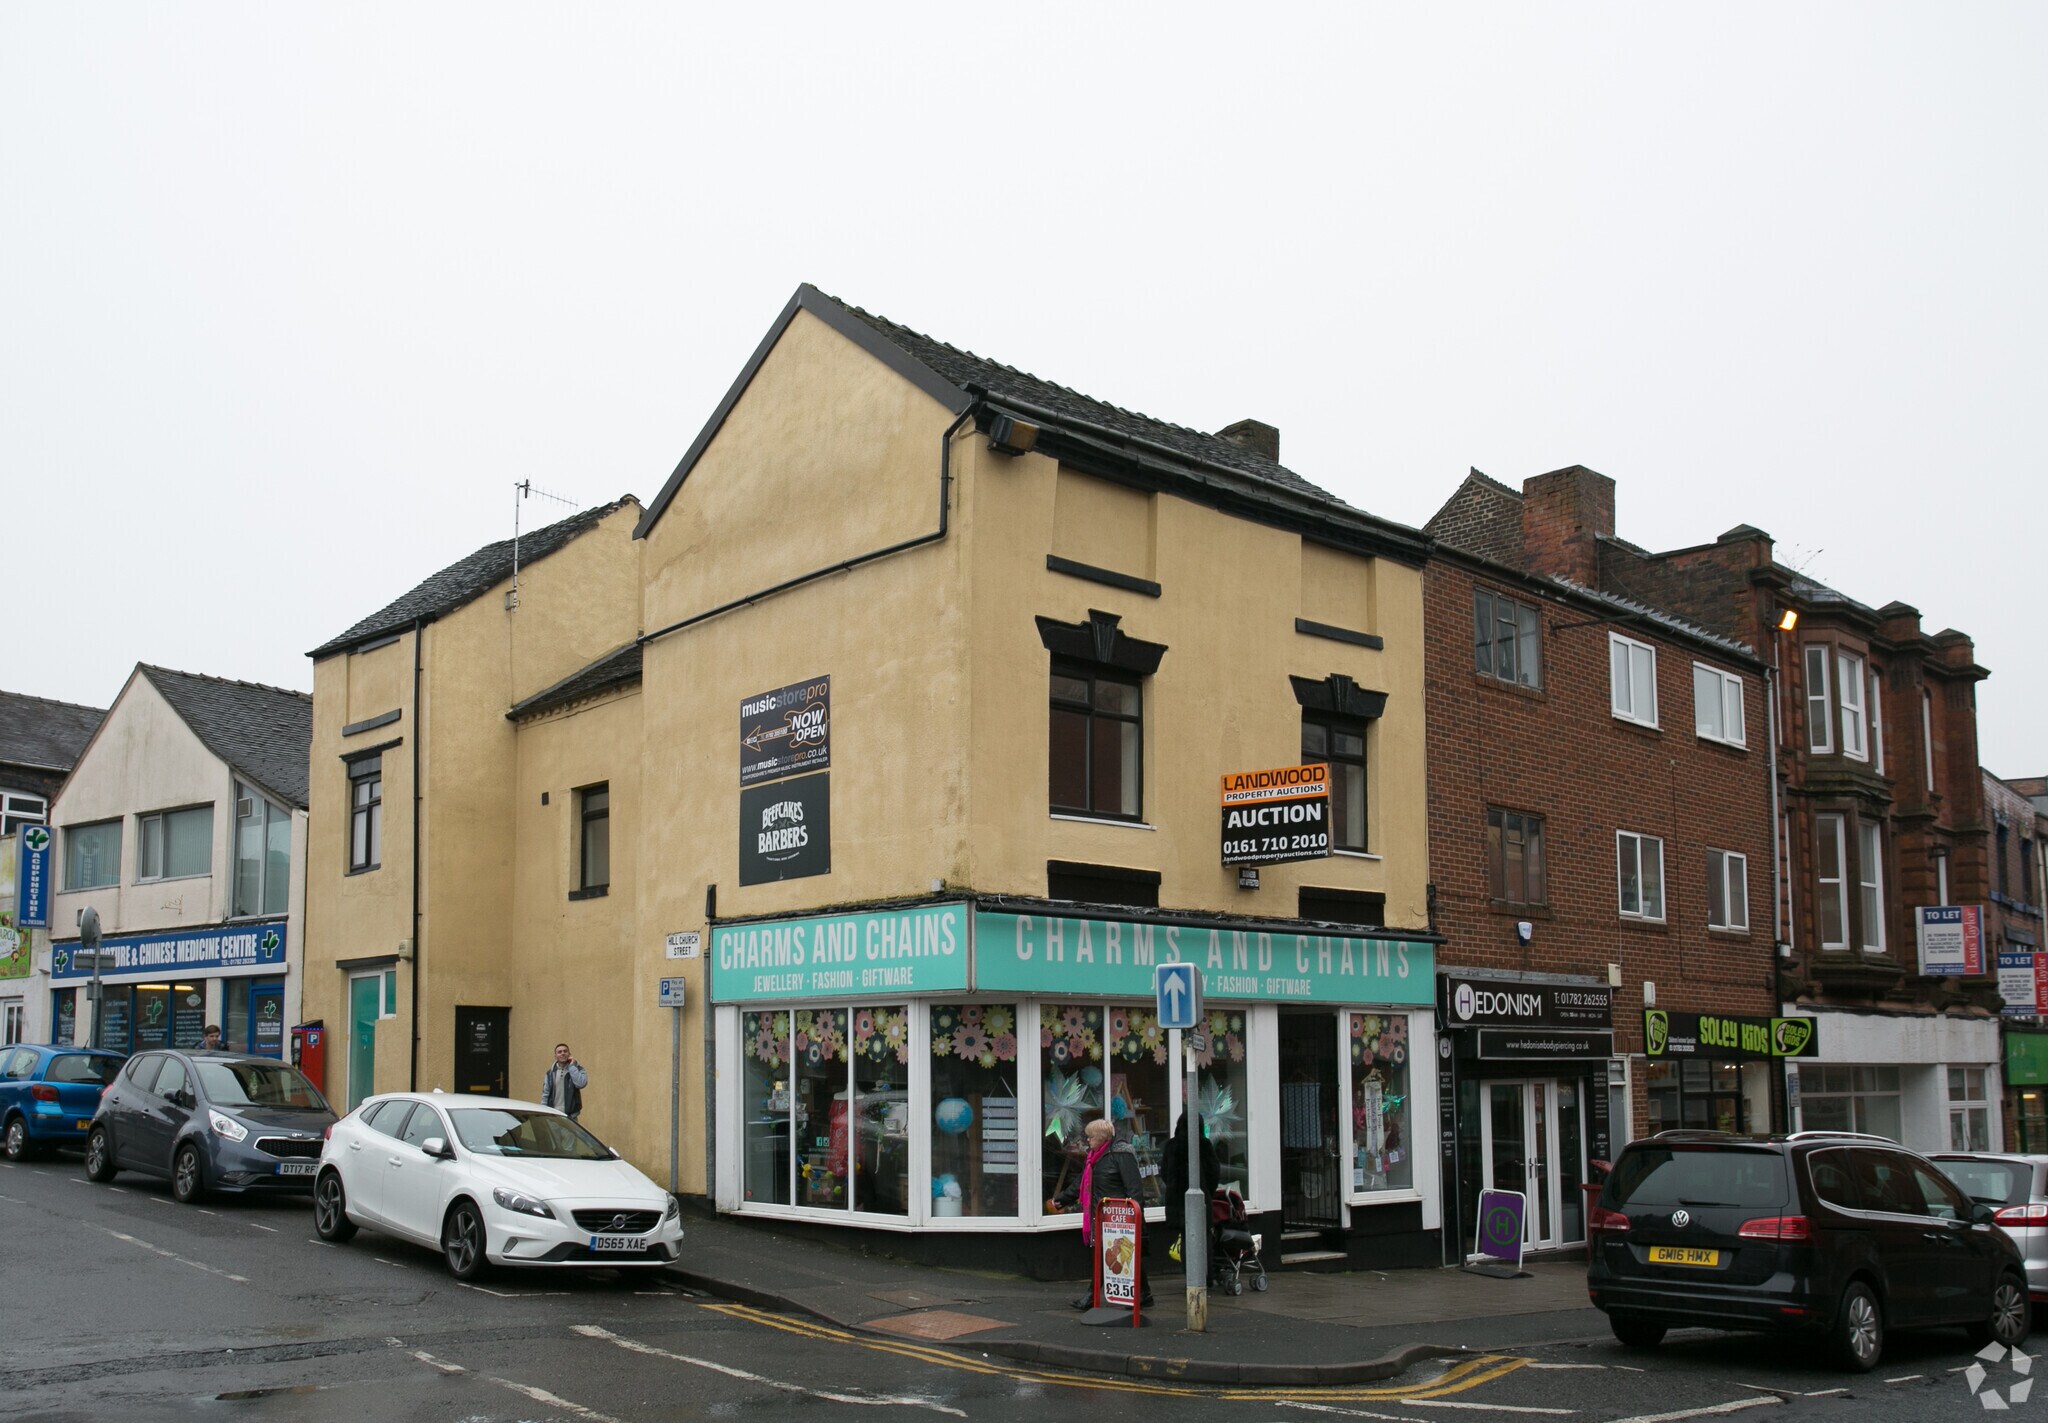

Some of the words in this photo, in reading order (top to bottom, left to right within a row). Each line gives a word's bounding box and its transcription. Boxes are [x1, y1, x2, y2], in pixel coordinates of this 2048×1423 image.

[742, 682, 828, 718] musicstorepro
[791, 708, 824, 731] NOW
[795, 723, 826, 742] OPEN
[742, 745, 828, 774] www.musicstorepro.co.uk
[1223, 766, 1325, 791] LANDWOOD
[1226, 789, 1274, 801] PROPERTY
[1276, 784, 1323, 796] AUCTIONS
[762, 801, 804, 829] BEEFCAKES
[1227, 803, 1321, 829] AUCTION
[758, 825, 808, 854] BARBERS
[1223, 839, 1258, 854] 0161
[1261, 836, 1288, 851] 710
[1291, 833, 1328, 849] 2010
[1223, 849, 1328, 862] landwoodpropertyauctions.com
[29, 852, 41, 918] ACUPUNCTURE
[1926, 911, 1939, 920] TO
[1942, 910, 1960, 919] LET
[1964, 911, 1980, 942] Taylor
[131, 948, 138, 965] &
[139, 938, 175, 964] CHINESE
[177, 936, 220, 962] MEDICINE
[221, 934, 257, 959] CENTRE
[668, 937, 679, 945] HILL
[679, 935, 699, 945] CHURCH
[720, 927, 805, 970] CHARMS
[812, 922, 857, 964] AND
[866, 912, 956, 960] CHAINS
[1015, 915, 1181, 964] CHARMS
[1207, 930, 1273, 972] AND
[1296, 935, 1410, 979] CHAINS
[673, 946, 691, 956] STREET
[1967, 943, 1978, 968] Louis
[2000, 957, 2012, 965] TO
[663, 982, 669, 994] P
[753, 972, 803, 992] JEWELLERY
[812, 969, 853, 990] FASHION
[862, 967, 914, 988] GIFTWARE
[1217, 975, 1258, 994] FASHION
[1266, 977, 1312, 996] GIFTWARE
[1459, 990, 1542, 1017] HEDONISM
[1554, 992, 1560, 1004] T:
[1560, 992, 1582, 1005] 01782
[1583, 993, 1608, 1006] 262555
[310, 1034, 318, 1043] P
[284, 1164, 303, 1173] DT17
[1102, 1206, 1135, 1216] POTTERIES
[1111, 1215, 1127, 1223] CAFE
[1495, 1215, 1509, 1236] H
[597, 1237, 624, 1249] DS65
[626, 1238, 646, 1249] XAE
[1658, 1248, 1684, 1261] GM16
[1687, 1249, 1711, 1263] HMX
